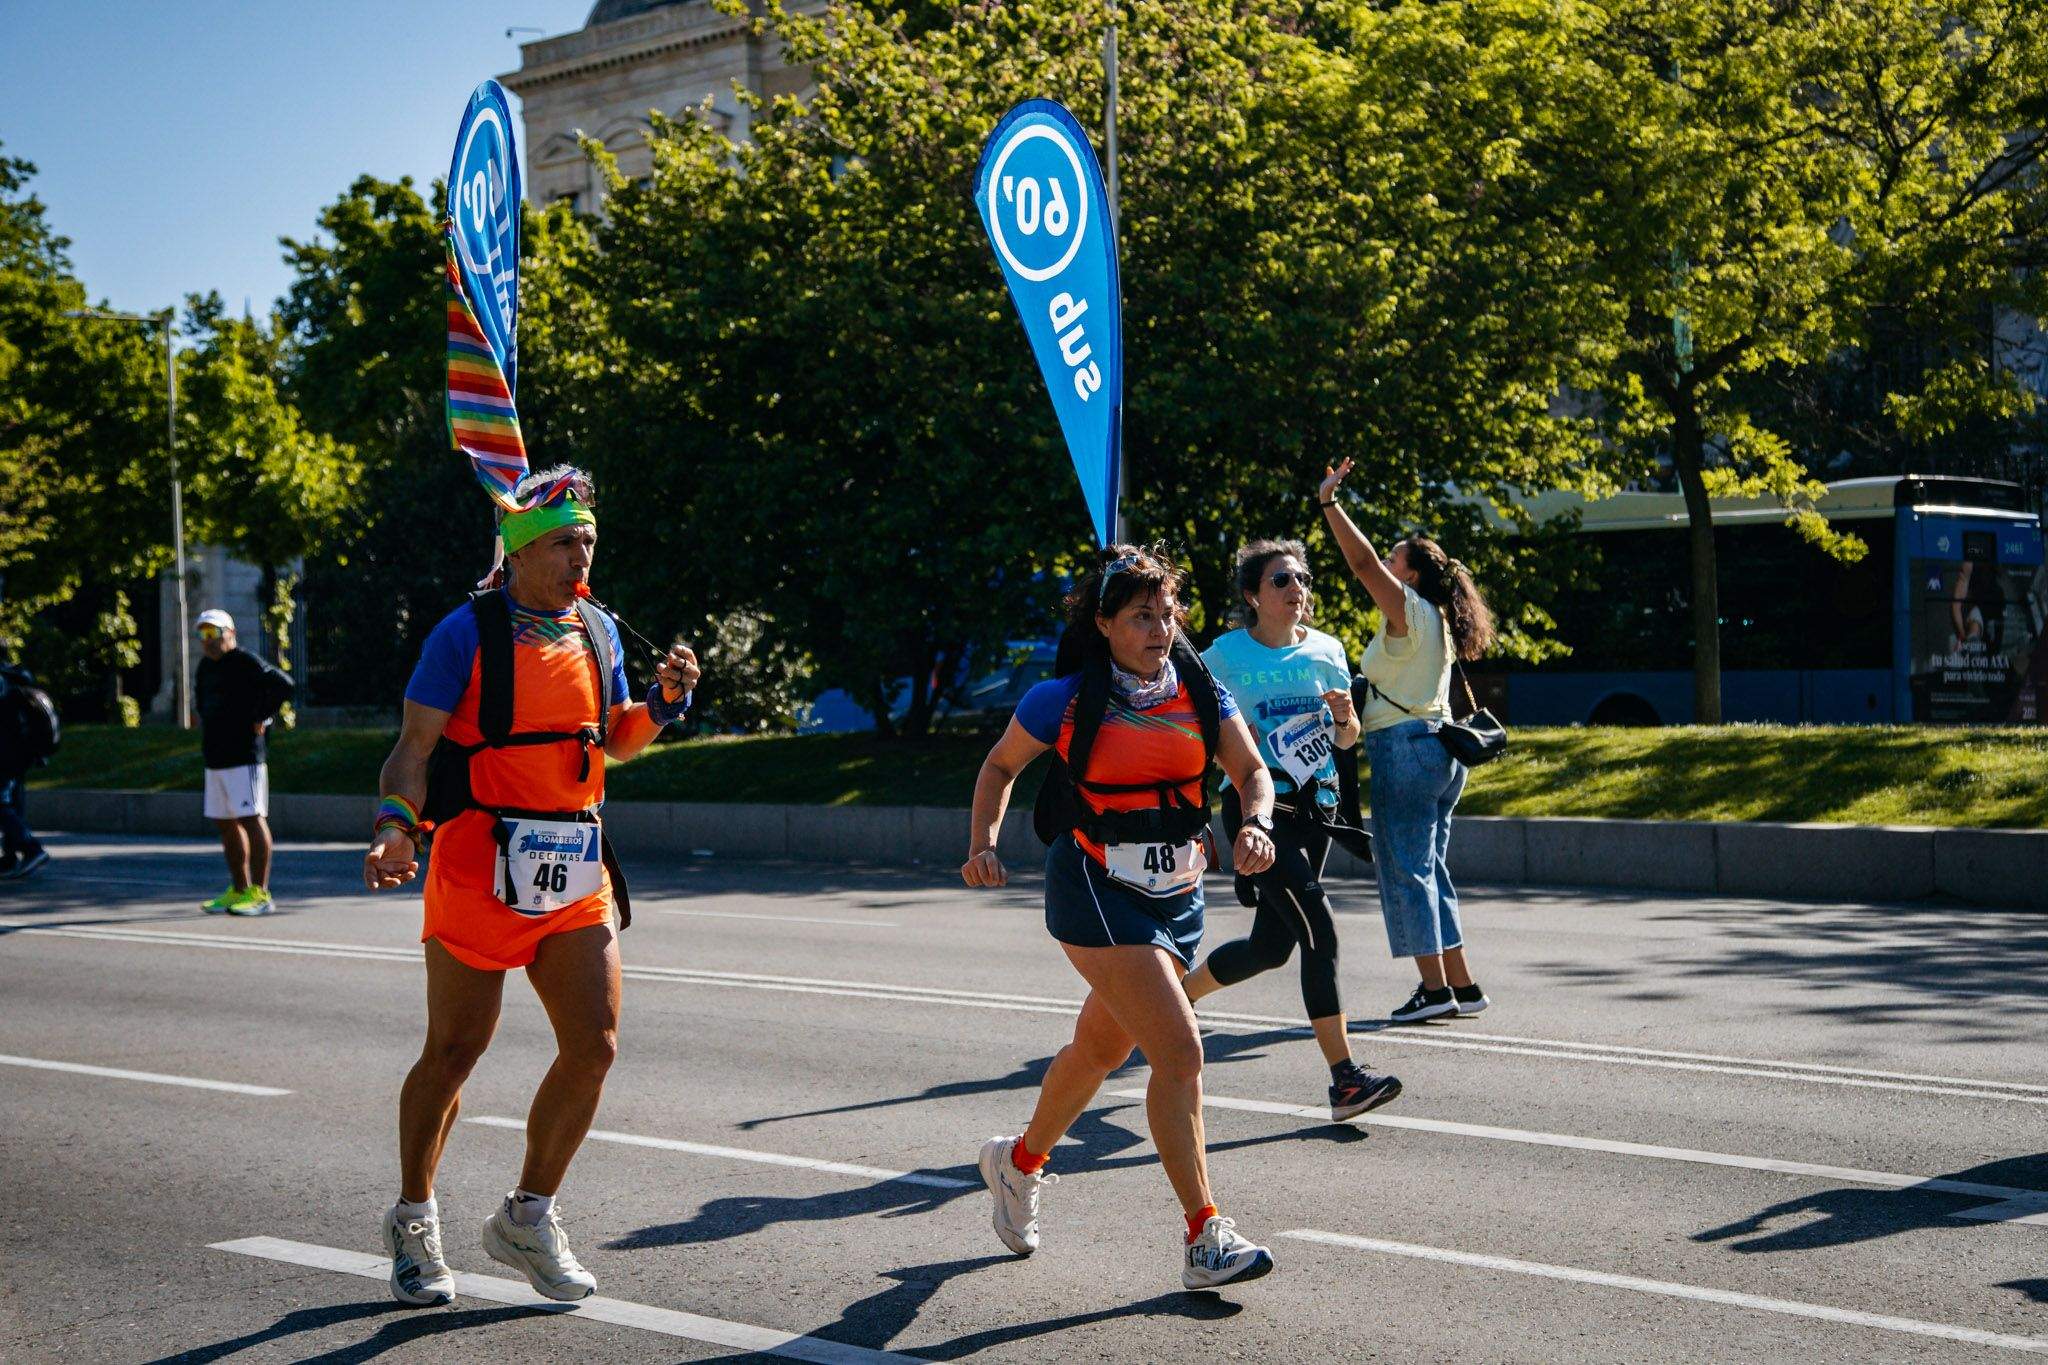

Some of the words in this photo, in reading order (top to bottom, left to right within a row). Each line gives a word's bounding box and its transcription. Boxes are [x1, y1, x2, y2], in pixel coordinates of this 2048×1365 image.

[1971, 655, 1989, 669] con
[1991, 654, 2010, 669] AXA
[1294, 733, 1335, 767] 1303
[537, 835, 582, 845] BOMBEROS
[529, 851, 580, 862] DECIMAS
[1143, 844, 1176, 874] 48
[533, 863, 568, 893] 46
